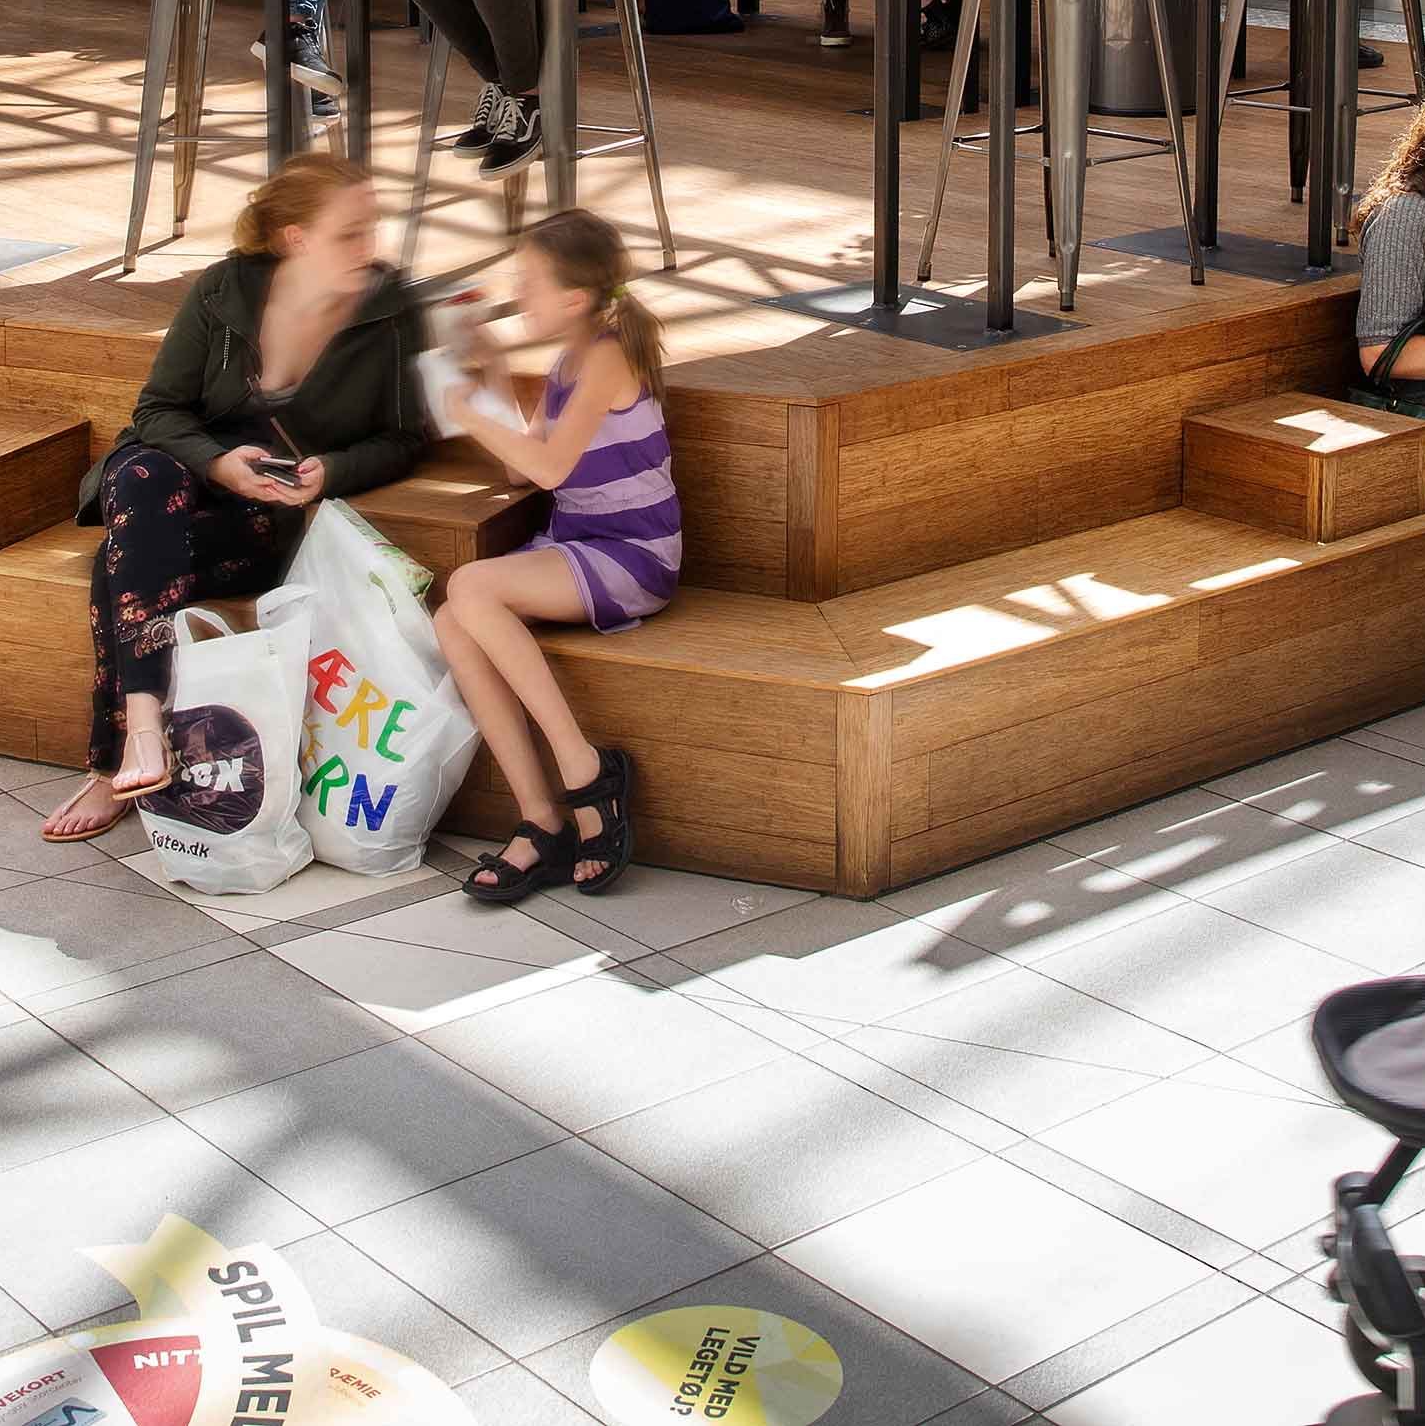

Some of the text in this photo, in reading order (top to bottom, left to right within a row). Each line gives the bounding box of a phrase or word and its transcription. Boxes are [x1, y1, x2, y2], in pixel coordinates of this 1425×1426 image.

[308, 647, 417, 763] ÆRE
[152, 830, 210, 859] føtex.dk
[208, 1261, 286, 1343] SPIL
[670, 1326, 731, 1416] LEGETØJ?
[704, 1336, 761, 1420] VILD MED
